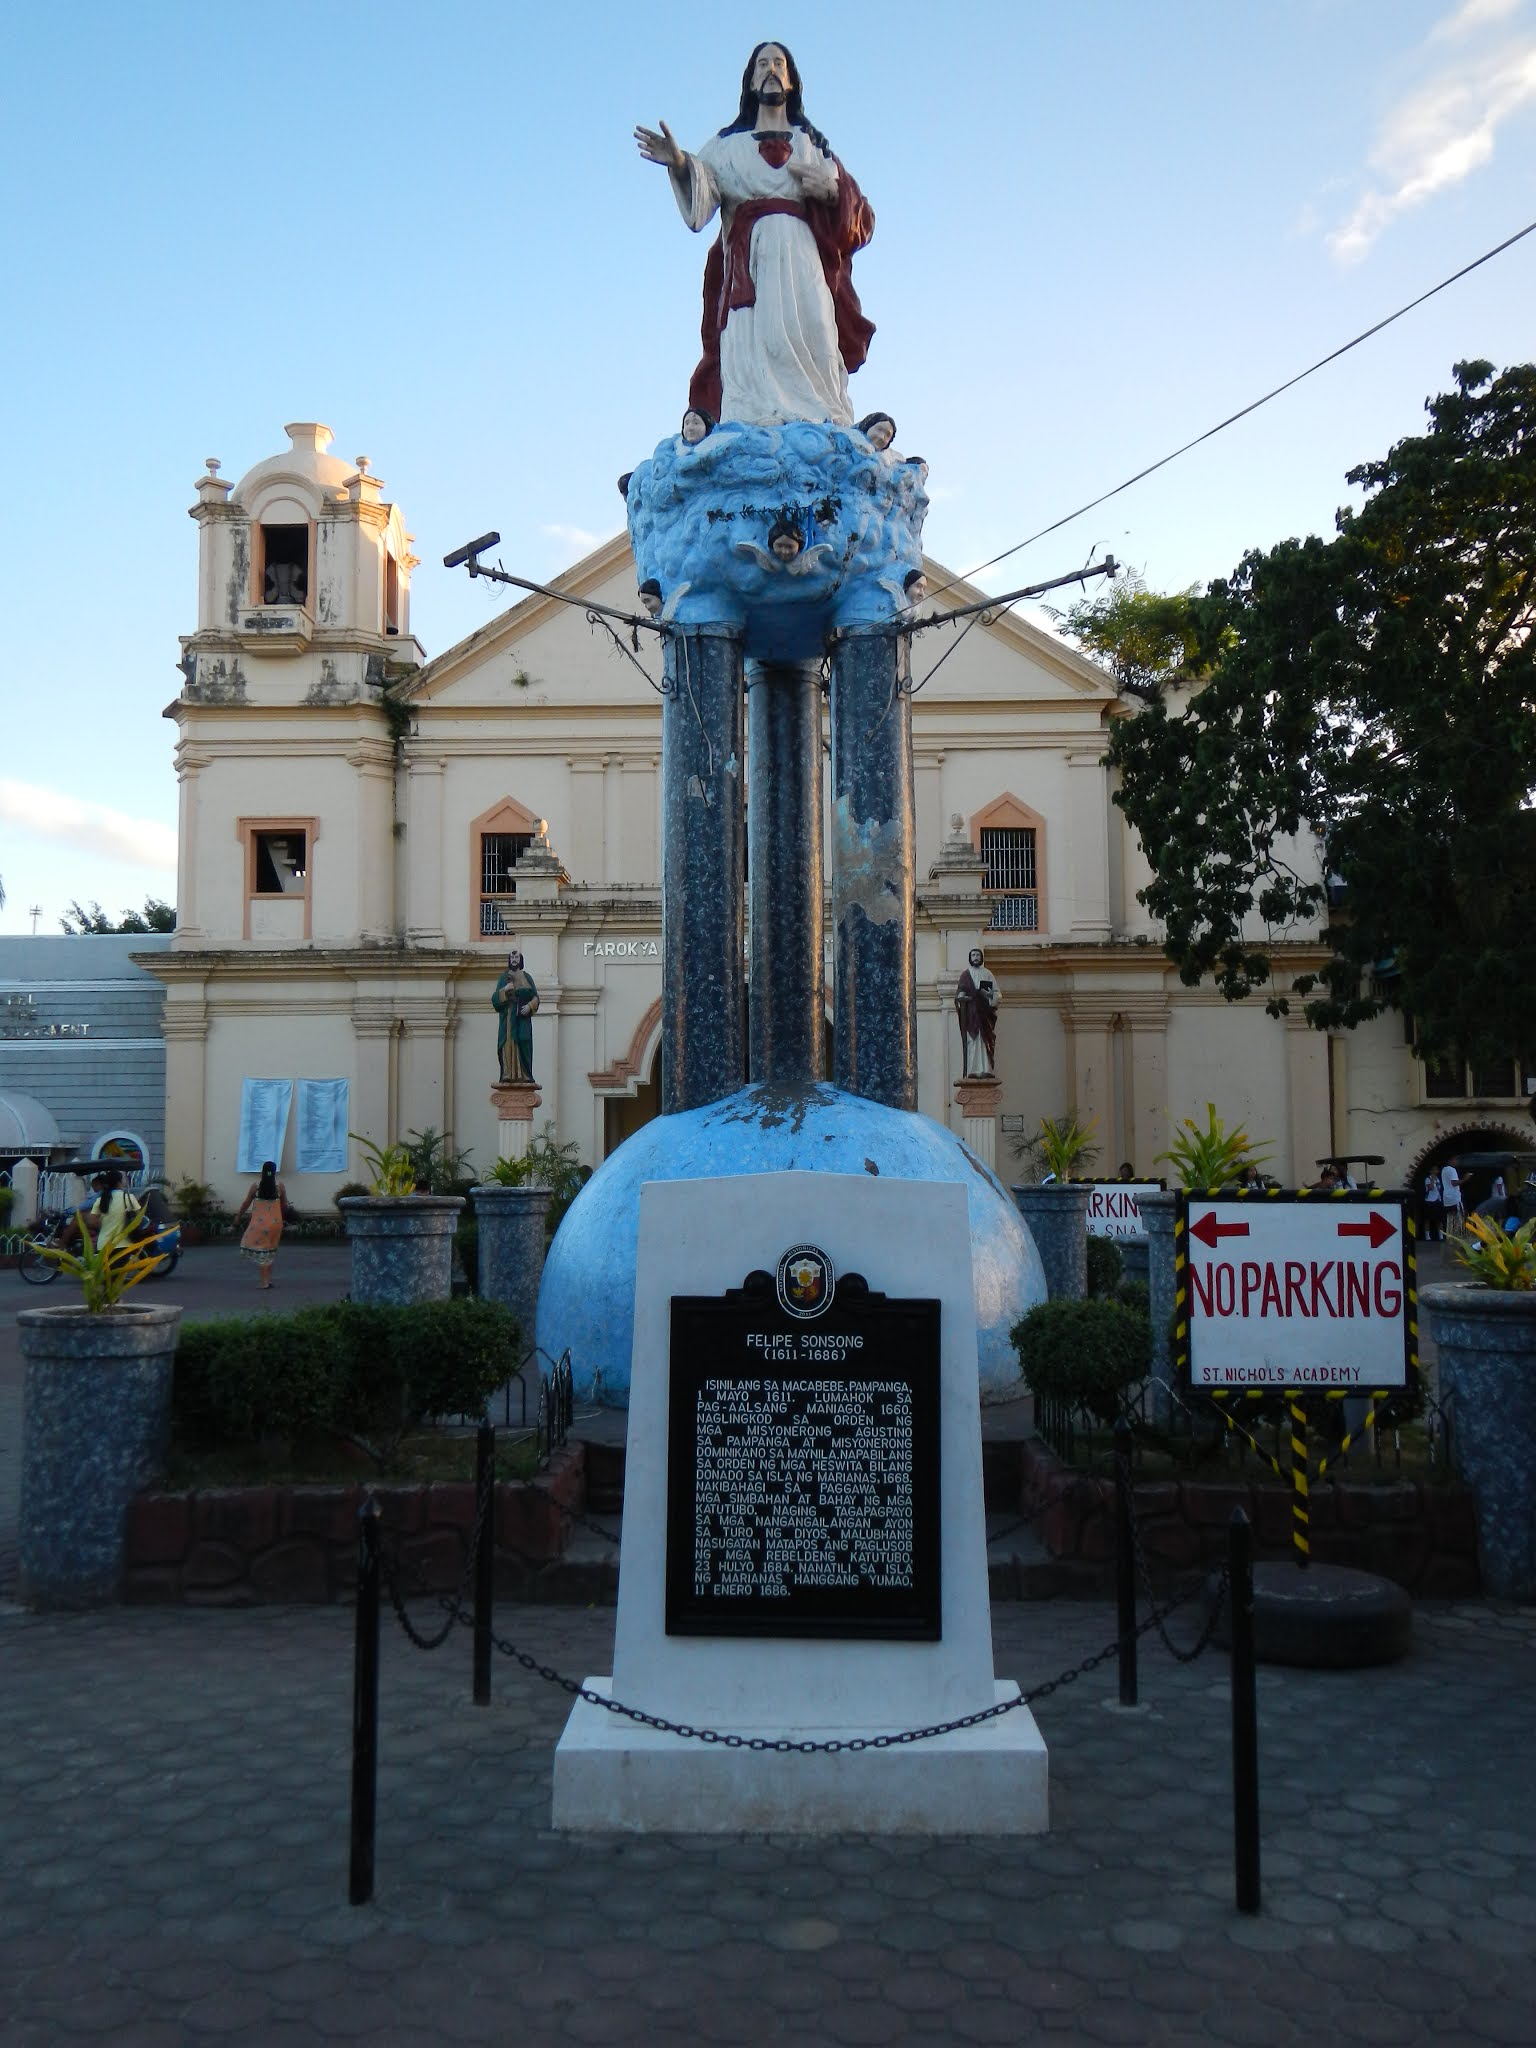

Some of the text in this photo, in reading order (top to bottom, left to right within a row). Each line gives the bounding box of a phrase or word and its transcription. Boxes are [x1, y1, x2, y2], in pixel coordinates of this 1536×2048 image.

[788, 1246, 819, 1256] HISTORICAL
[1242, 1261, 1401, 1318] PARKING
[746, 1334, 864, 1349] FELIPE SONSONG
[1293, 1367, 1361, 1381] ACADEMY
[705, 1380, 761, 1391] ISINILANG
[763, 1380, 779, 1391] SA
[716, 1391, 749, 1401] MAYO
[766, 1391, 796, 1402] 1611.
[815, 1392, 873, 1403] LUMAHOK
[896, 1393, 913, 1404] SA
[881, 1404, 913, 1415] 1660.
[696, 1413, 913, 1426] NAGLINGKOD SA ORDEN NG
[696, 1425, 913, 1437] MGA MISYONERONG AGUSTINO
[697, 1436, 913, 1449] SA PAMPANGA AT MISYONERONG
[696, 1447, 766, 1458] DOMINIKANO
[769, 1448, 784, 1458] SA
[697, 1458, 913, 1472] SA ORDEN NG MGA HESWITA BILANG
[696, 1470, 913, 1484] DONADO SA ISLA NG MARIANAS, 1668.
[696, 1481, 913, 1495] NAKIBAHAGI SA PAGGAWA NG
[695, 1492, 913, 1506] MGA SIMBAHAN AT BAHAY NG MGA
[695, 1504, 913, 1518] KATUTUBO. NAGING TAGAPAGPAYO
[696, 1515, 913, 1529] SA MGA NANGANGAILANGAN AYON
[696, 1527, 913, 1540] SA TURO NG DIYOS. MALUBHANG
[695, 1538, 913, 1552] NASUGATAN MATAPOS ANG PAGLUSOB
[695, 1549, 711, 1560] NG
[725, 1550, 751, 1561] MGA
[766, 1551, 836, 1562] REBELDENG
[695, 1561, 913, 1575] 23 HULYO 1684. NANATILI SA ISLA
[695, 1572, 913, 1588] NG MARIANAS HANGGANG YUMAO,
[695, 1585, 791, 1597] 11 ENERO 1686.
